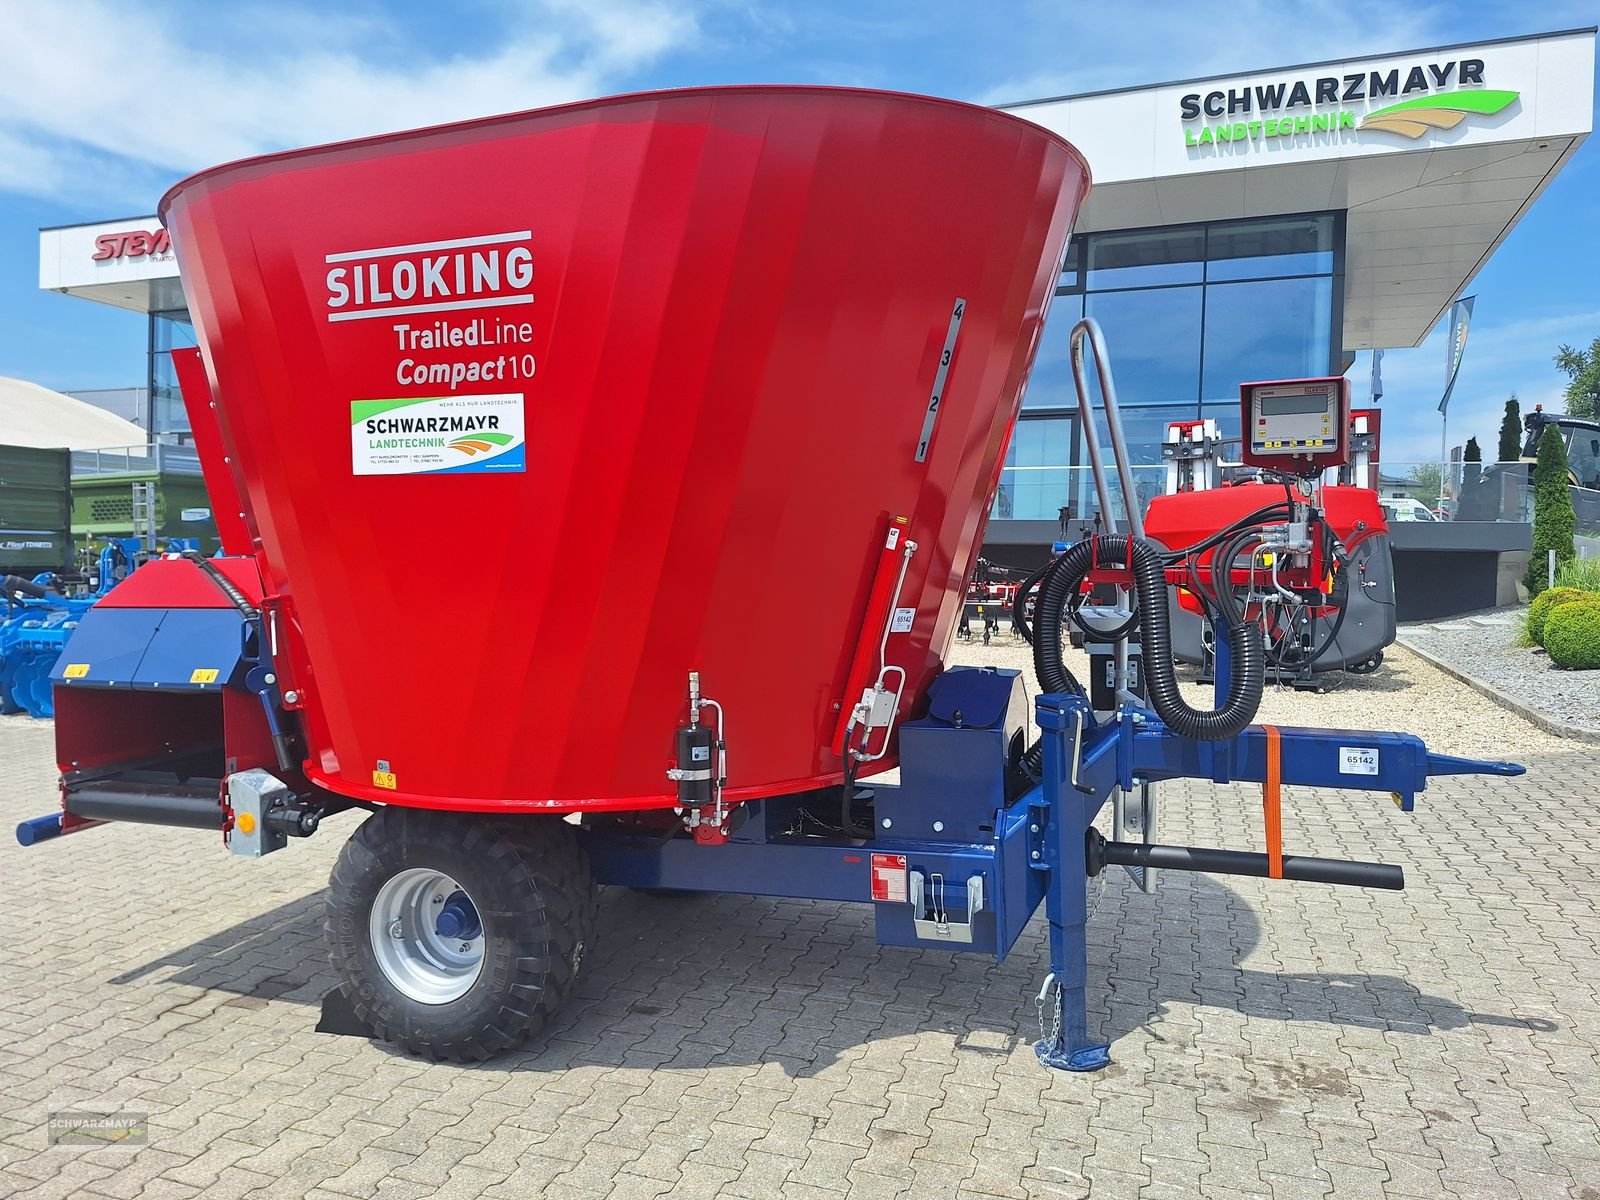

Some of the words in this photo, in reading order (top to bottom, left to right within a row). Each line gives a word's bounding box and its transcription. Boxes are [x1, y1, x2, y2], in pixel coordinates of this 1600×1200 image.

[1180, 58, 1485, 120] SCHWARZMAYR
[1184, 110, 1356, 147] LANDTECHNIK
[326, 247, 534, 307] SILOKING
[953, 303, 963, 320] 4
[393, 317, 533, 350] TrailedLine
[941, 350, 951, 366] 3
[396, 354, 536, 390] Compact10
[928, 396, 939, 412] 2
[366, 415, 499, 434] SCHWARZMAYR
[369, 437, 445, 449] LANDTECHNIK
[920, 441, 927, 457] 1
[897, 615, 912, 623] 65142
[1347, 755, 1374, 764] 65142
